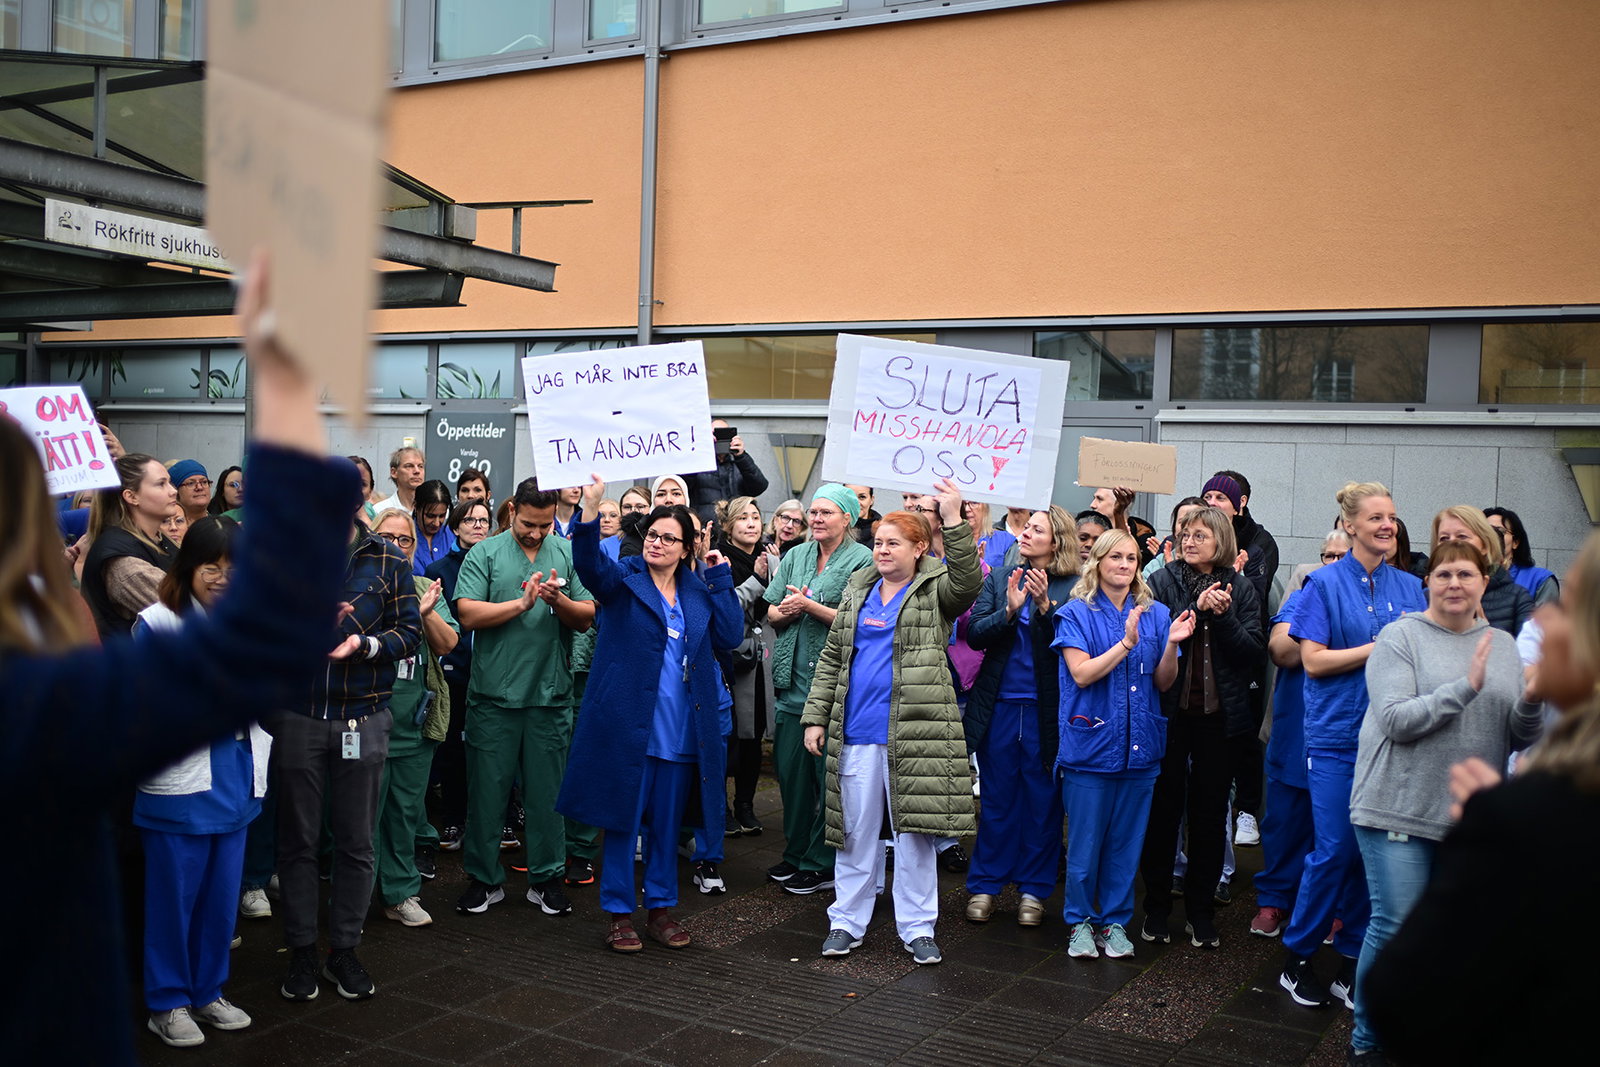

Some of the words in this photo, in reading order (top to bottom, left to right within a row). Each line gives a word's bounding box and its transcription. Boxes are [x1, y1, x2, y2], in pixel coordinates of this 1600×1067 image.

[95, 220, 156, 247] Rökfritt
[532, 372, 565, 395] JAG
[575, 363, 613, 385] MÅR
[623, 364, 659, 381] INTE
[665, 361, 698, 378] BRA
[876, 355, 1021, 424] SLUTA
[36, 393, 95, 426] OM,
[437, 417, 507, 441] Öppettider
[853, 408, 1028, 455] MISSHANDLA
[34, 429, 106, 473] ÄTT!
[460, 448, 479, 458] Vardag
[548, 437, 582, 464] TA
[592, 430, 682, 462] ANSVAR
